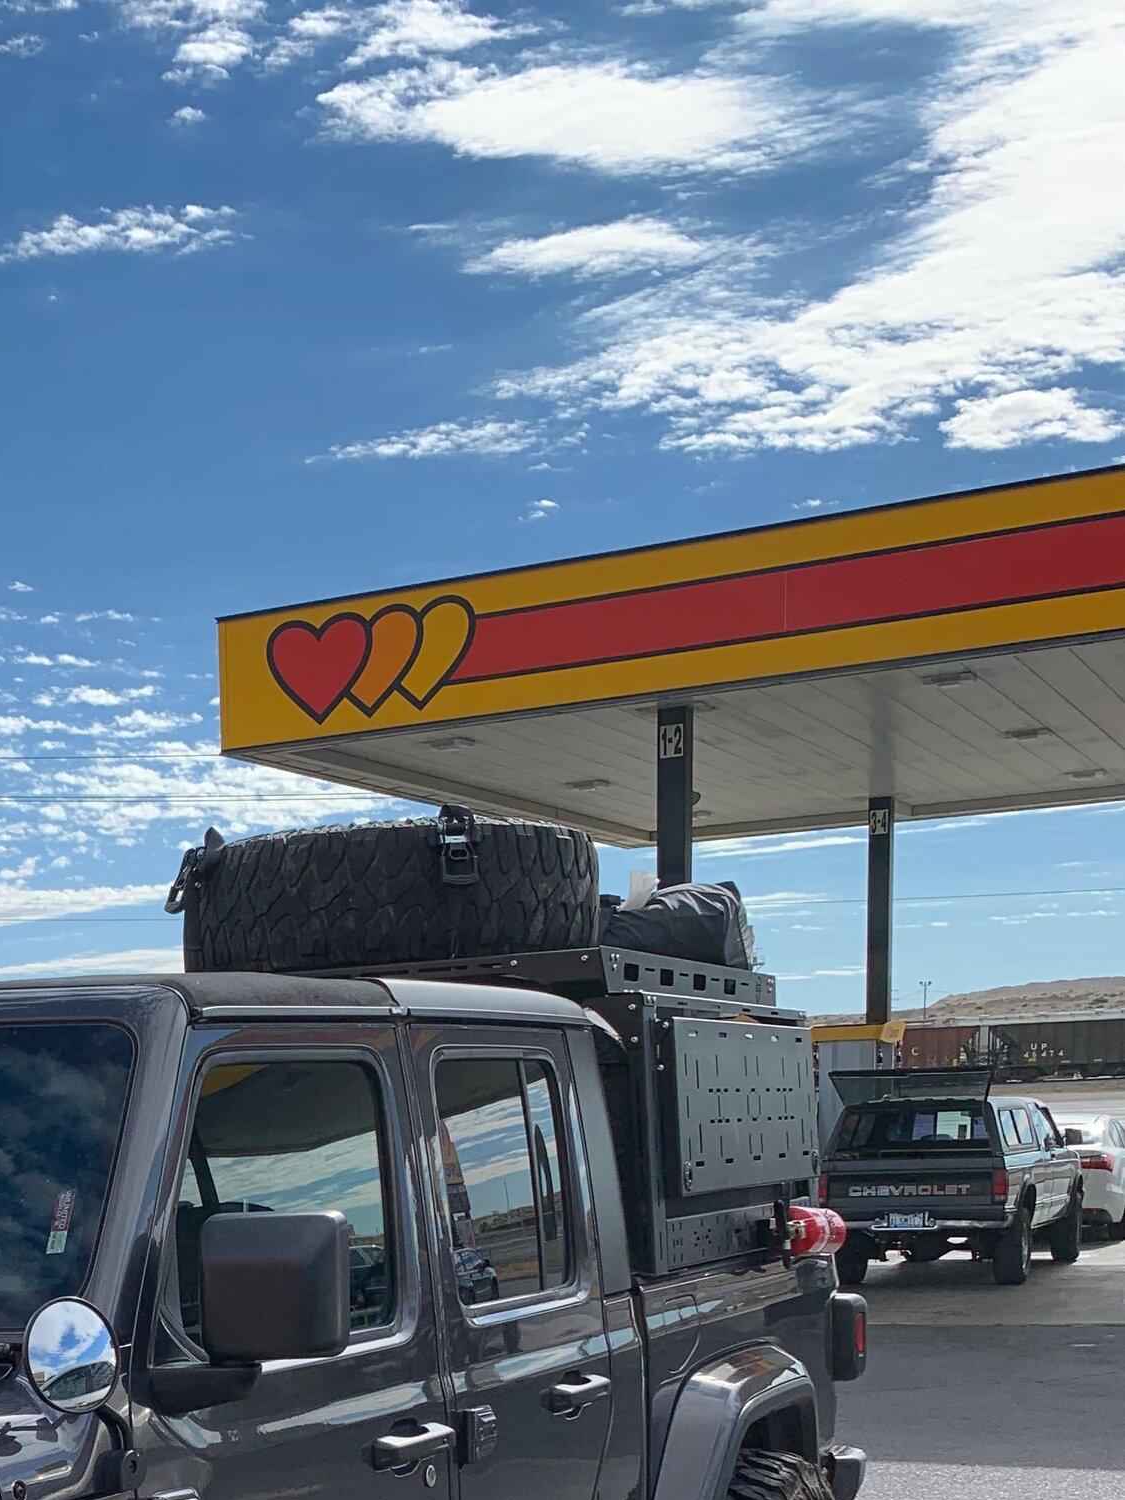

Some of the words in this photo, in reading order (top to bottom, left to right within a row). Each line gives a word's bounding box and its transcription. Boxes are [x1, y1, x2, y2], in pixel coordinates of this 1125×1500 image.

[661, 725, 682, 756] 1-2
[870, 811, 887, 833] 3-4
[848, 1184, 971, 1197] CHEVROLET
